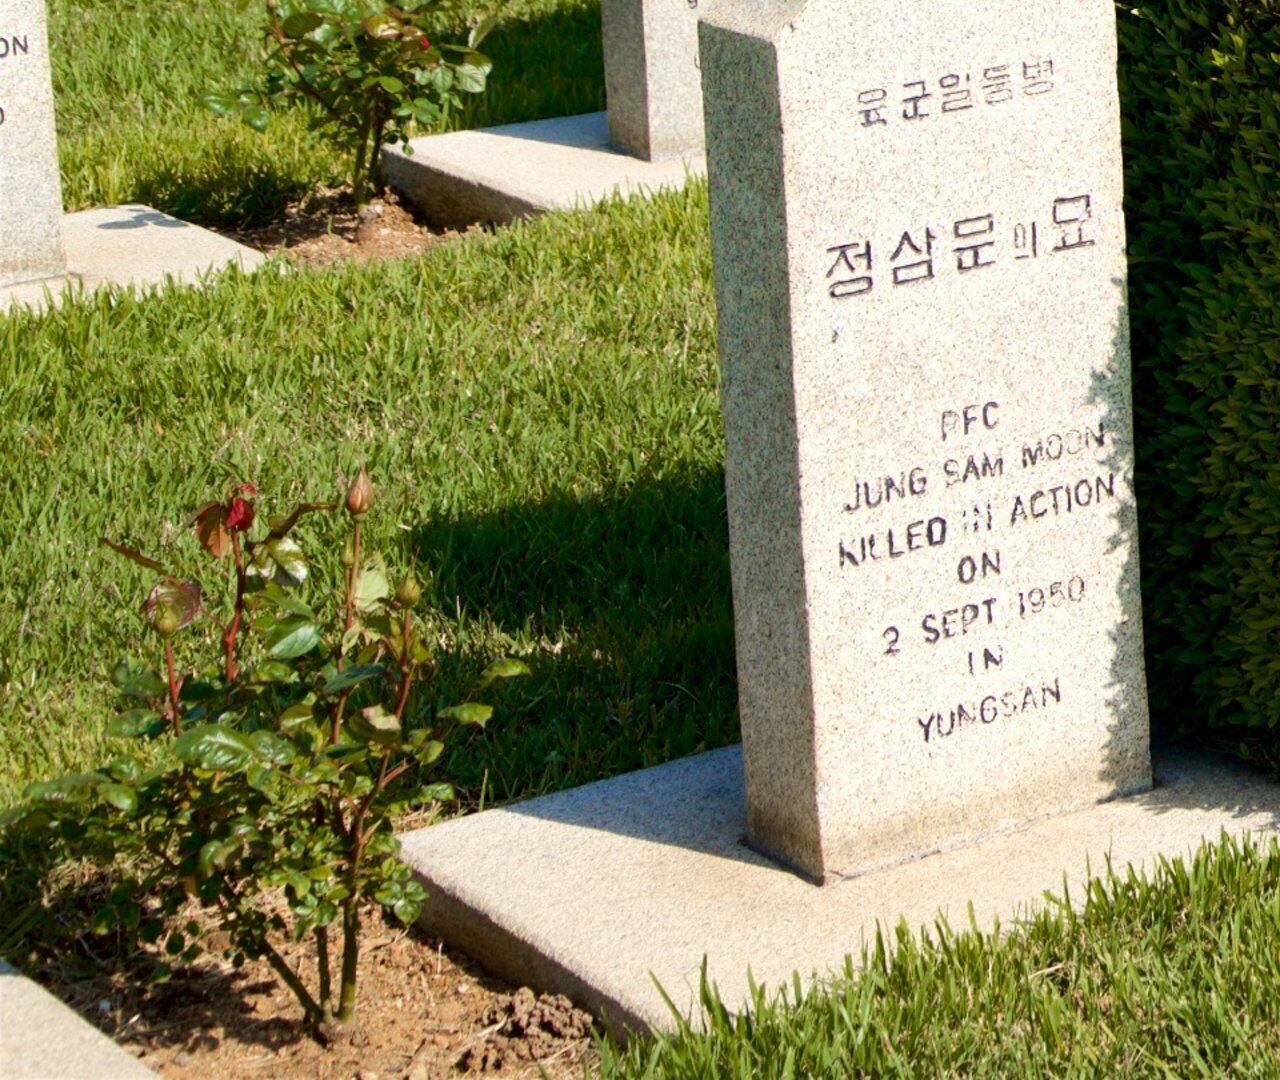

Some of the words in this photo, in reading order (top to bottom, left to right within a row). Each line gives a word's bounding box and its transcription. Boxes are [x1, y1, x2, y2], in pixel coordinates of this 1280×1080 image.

[856, 58, 1055, 128] 육군일등병
[940, 401, 1000, 442] PFC
[842, 467, 928, 514] JUNG
[943, 451, 1004, 488] SAM
[1021, 422, 1106, 470] MOON
[838, 516, 947, 568] KILLED
[961, 502, 993, 535] IN
[1010, 472, 1116, 526] ACTION
[956, 551, 1002, 585] ON
[882, 625, 901, 656] 2
[921, 597, 998, 645] SEPT
[1017, 574, 1086, 620] 1950
[967, 646, 1004, 675] IN
[918, 677, 1062, 743] YUNGSAN
